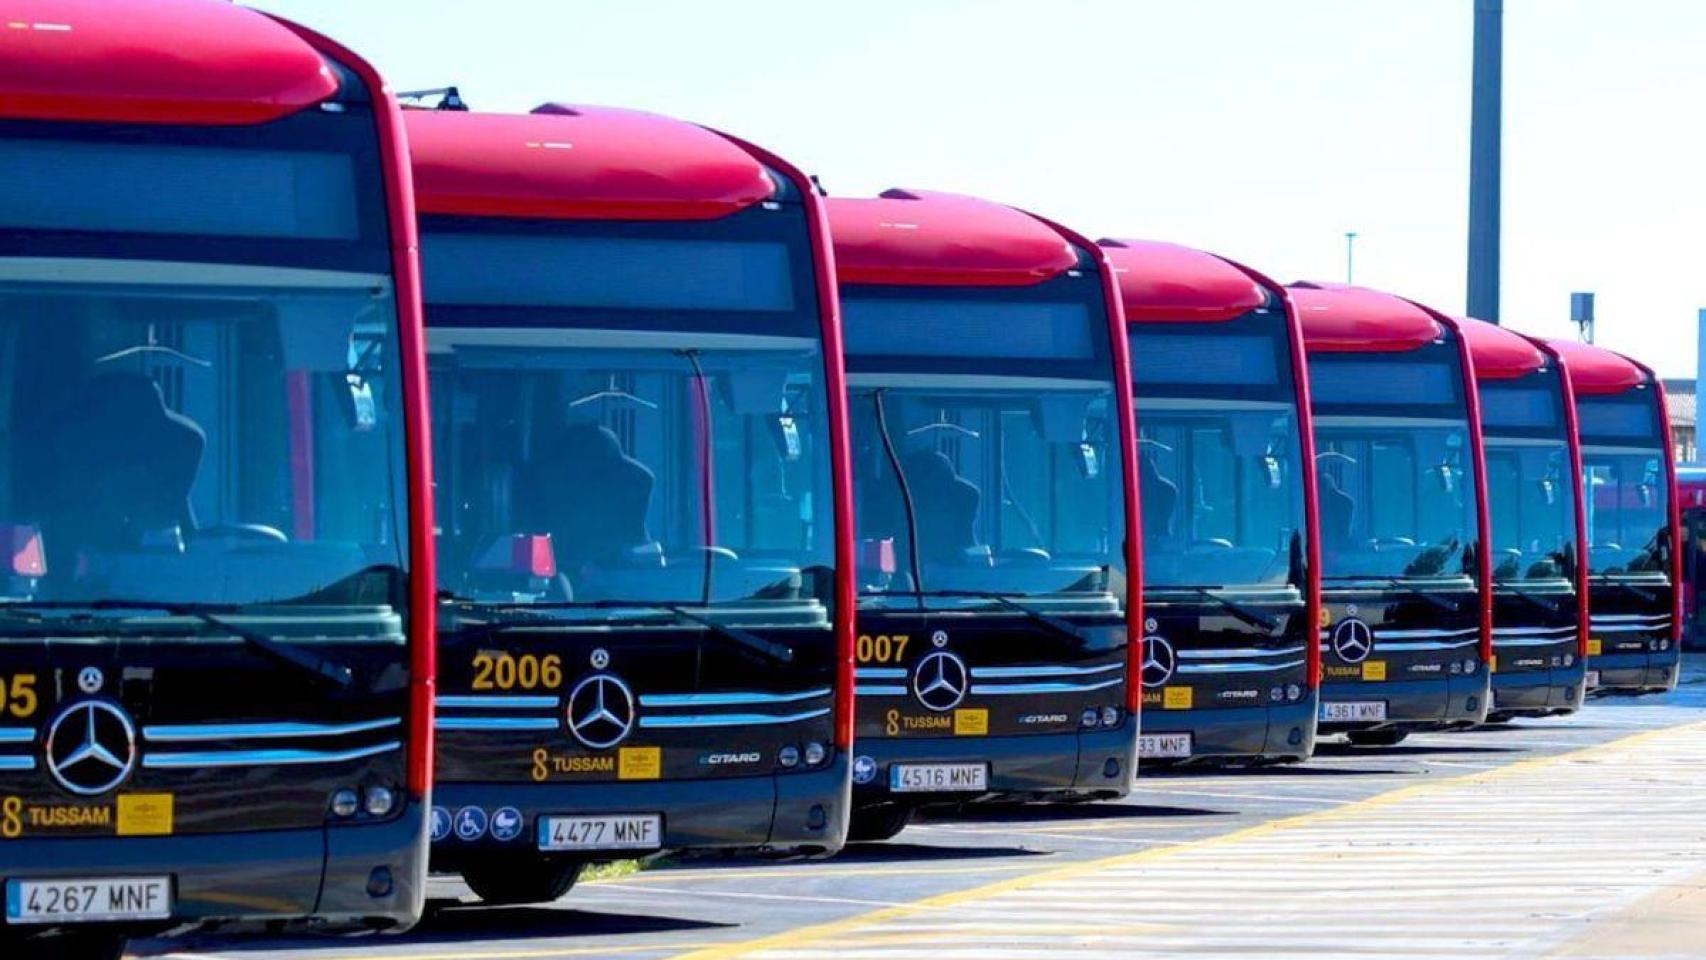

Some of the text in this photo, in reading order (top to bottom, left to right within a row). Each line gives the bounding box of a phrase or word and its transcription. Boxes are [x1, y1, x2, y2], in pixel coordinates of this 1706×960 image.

[472, 655, 562, 690] 2006
[0, 673, 37, 717] 5
[903, 716, 951, 728] TUSSAM
[553, 757, 613, 771] TUSSAM
[902, 767, 982, 785] 4516 MNF
[29, 806, 110, 826] TUSSAM
[553, 820, 651, 842] 4477 MNF
[27, 883, 161, 914] 4267 MNF
